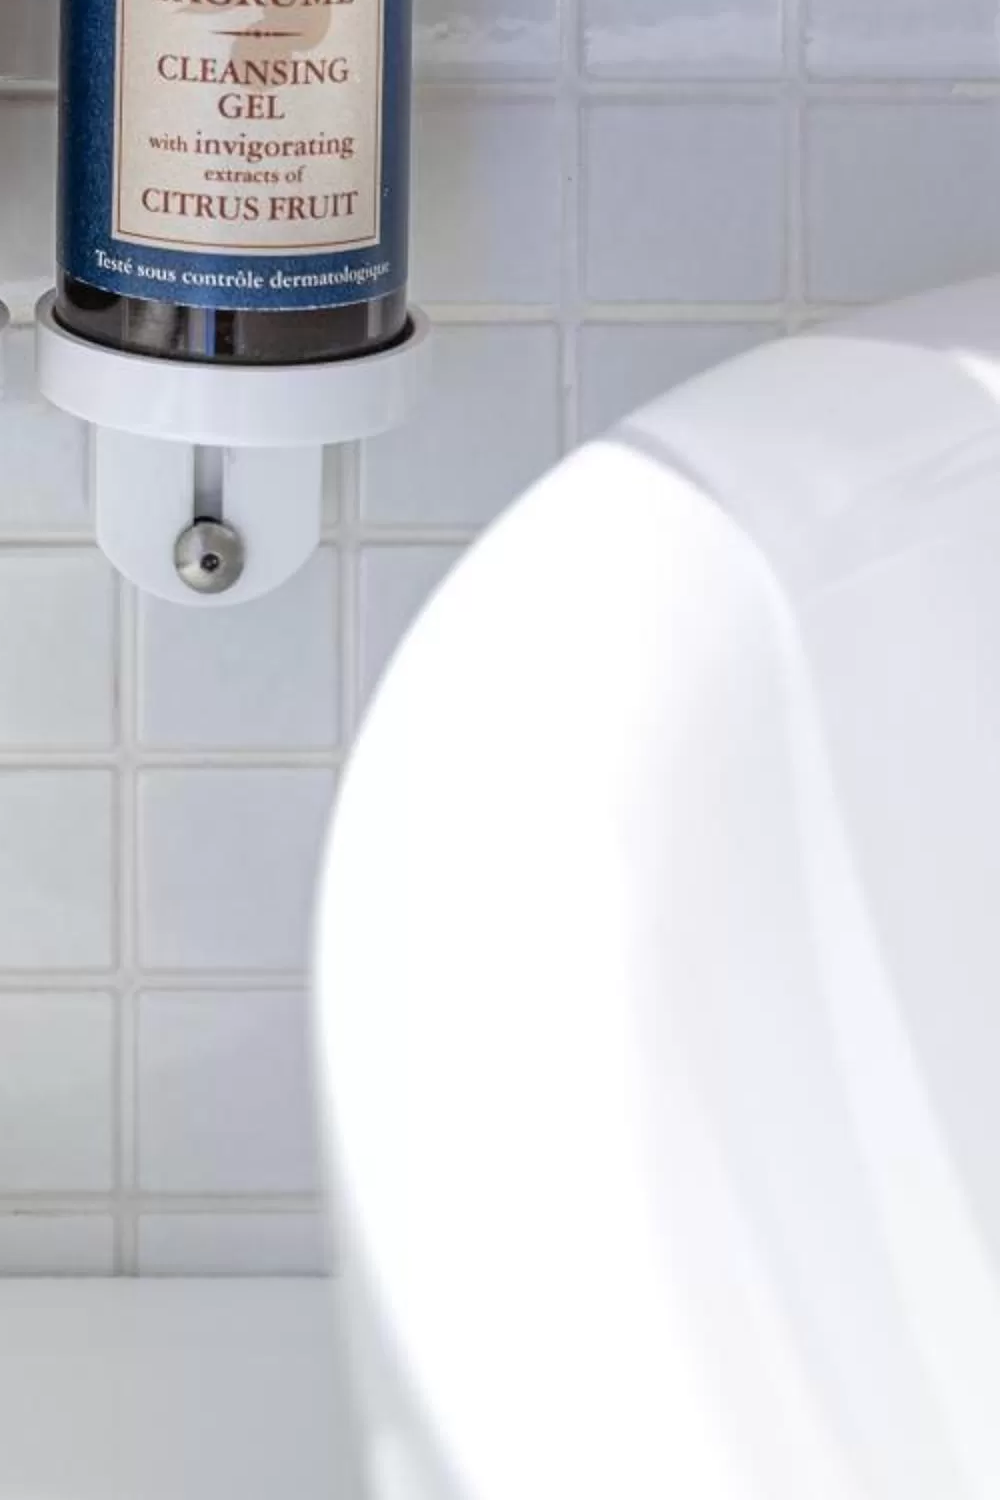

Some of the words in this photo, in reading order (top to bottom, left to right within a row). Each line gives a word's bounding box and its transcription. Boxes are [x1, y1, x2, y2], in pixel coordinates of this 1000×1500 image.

[157, 55, 349, 86] CLEANSING
[217, 93, 285, 120] GEL
[149, 133, 188, 153] with
[195, 131, 355, 162] invigorating
[204, 167, 279, 183] extracts
[285, 166, 306, 182] of
[141, 188, 260, 221] CITRUS
[267, 191, 359, 220] FRUIT
[95, 249, 132, 271] Testé
[137, 264, 176, 283] sous
[182, 270, 264, 289] contrôle
[270, 260, 391, 289] dermatologique
